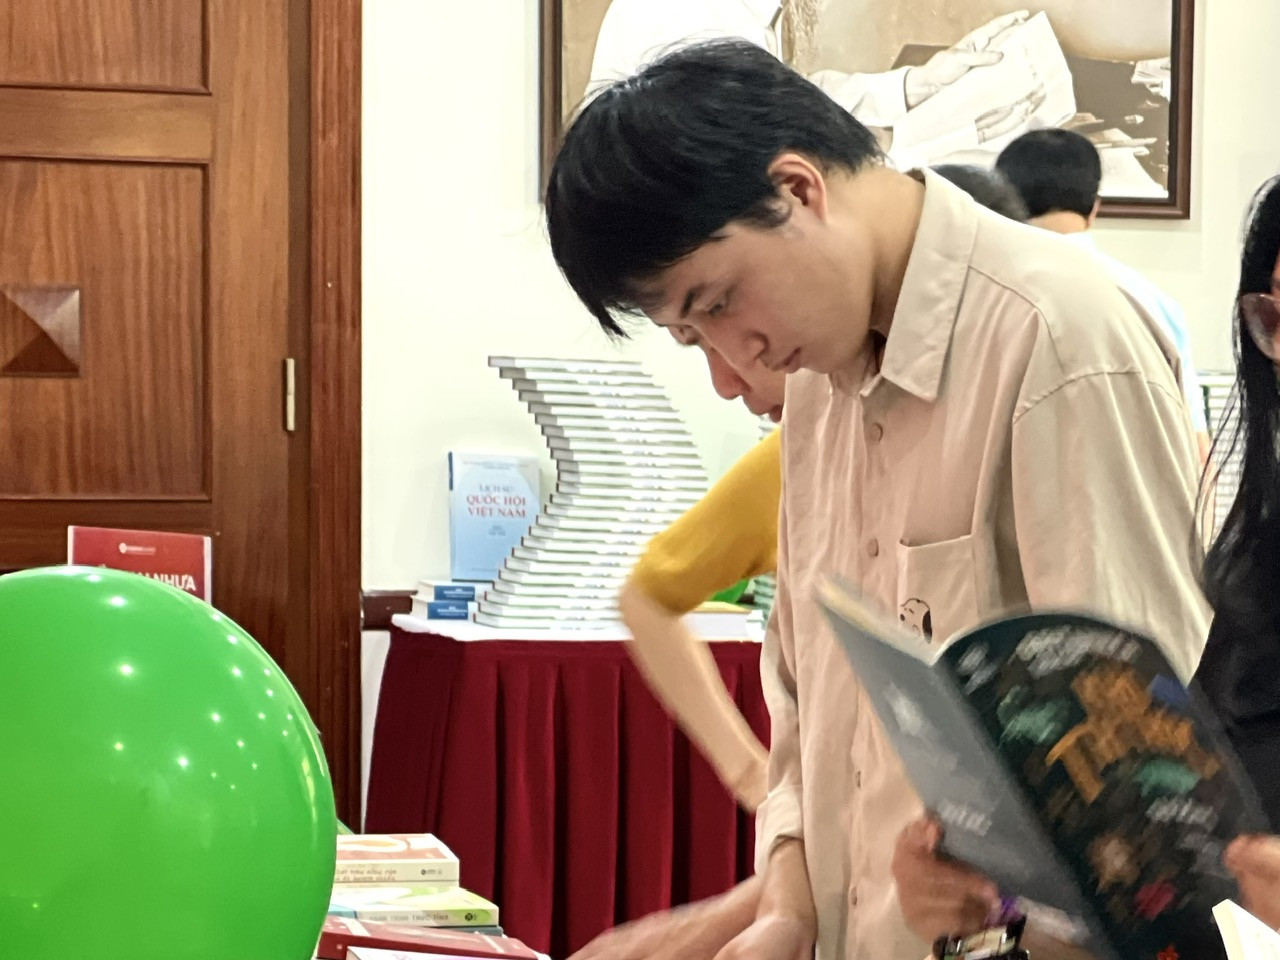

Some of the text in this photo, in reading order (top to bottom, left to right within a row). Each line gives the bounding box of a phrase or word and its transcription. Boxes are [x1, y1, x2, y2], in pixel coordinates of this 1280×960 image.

[466, 493, 526, 506] QUỐC HỘI
[468, 506, 526, 518] VIỆT NAM
